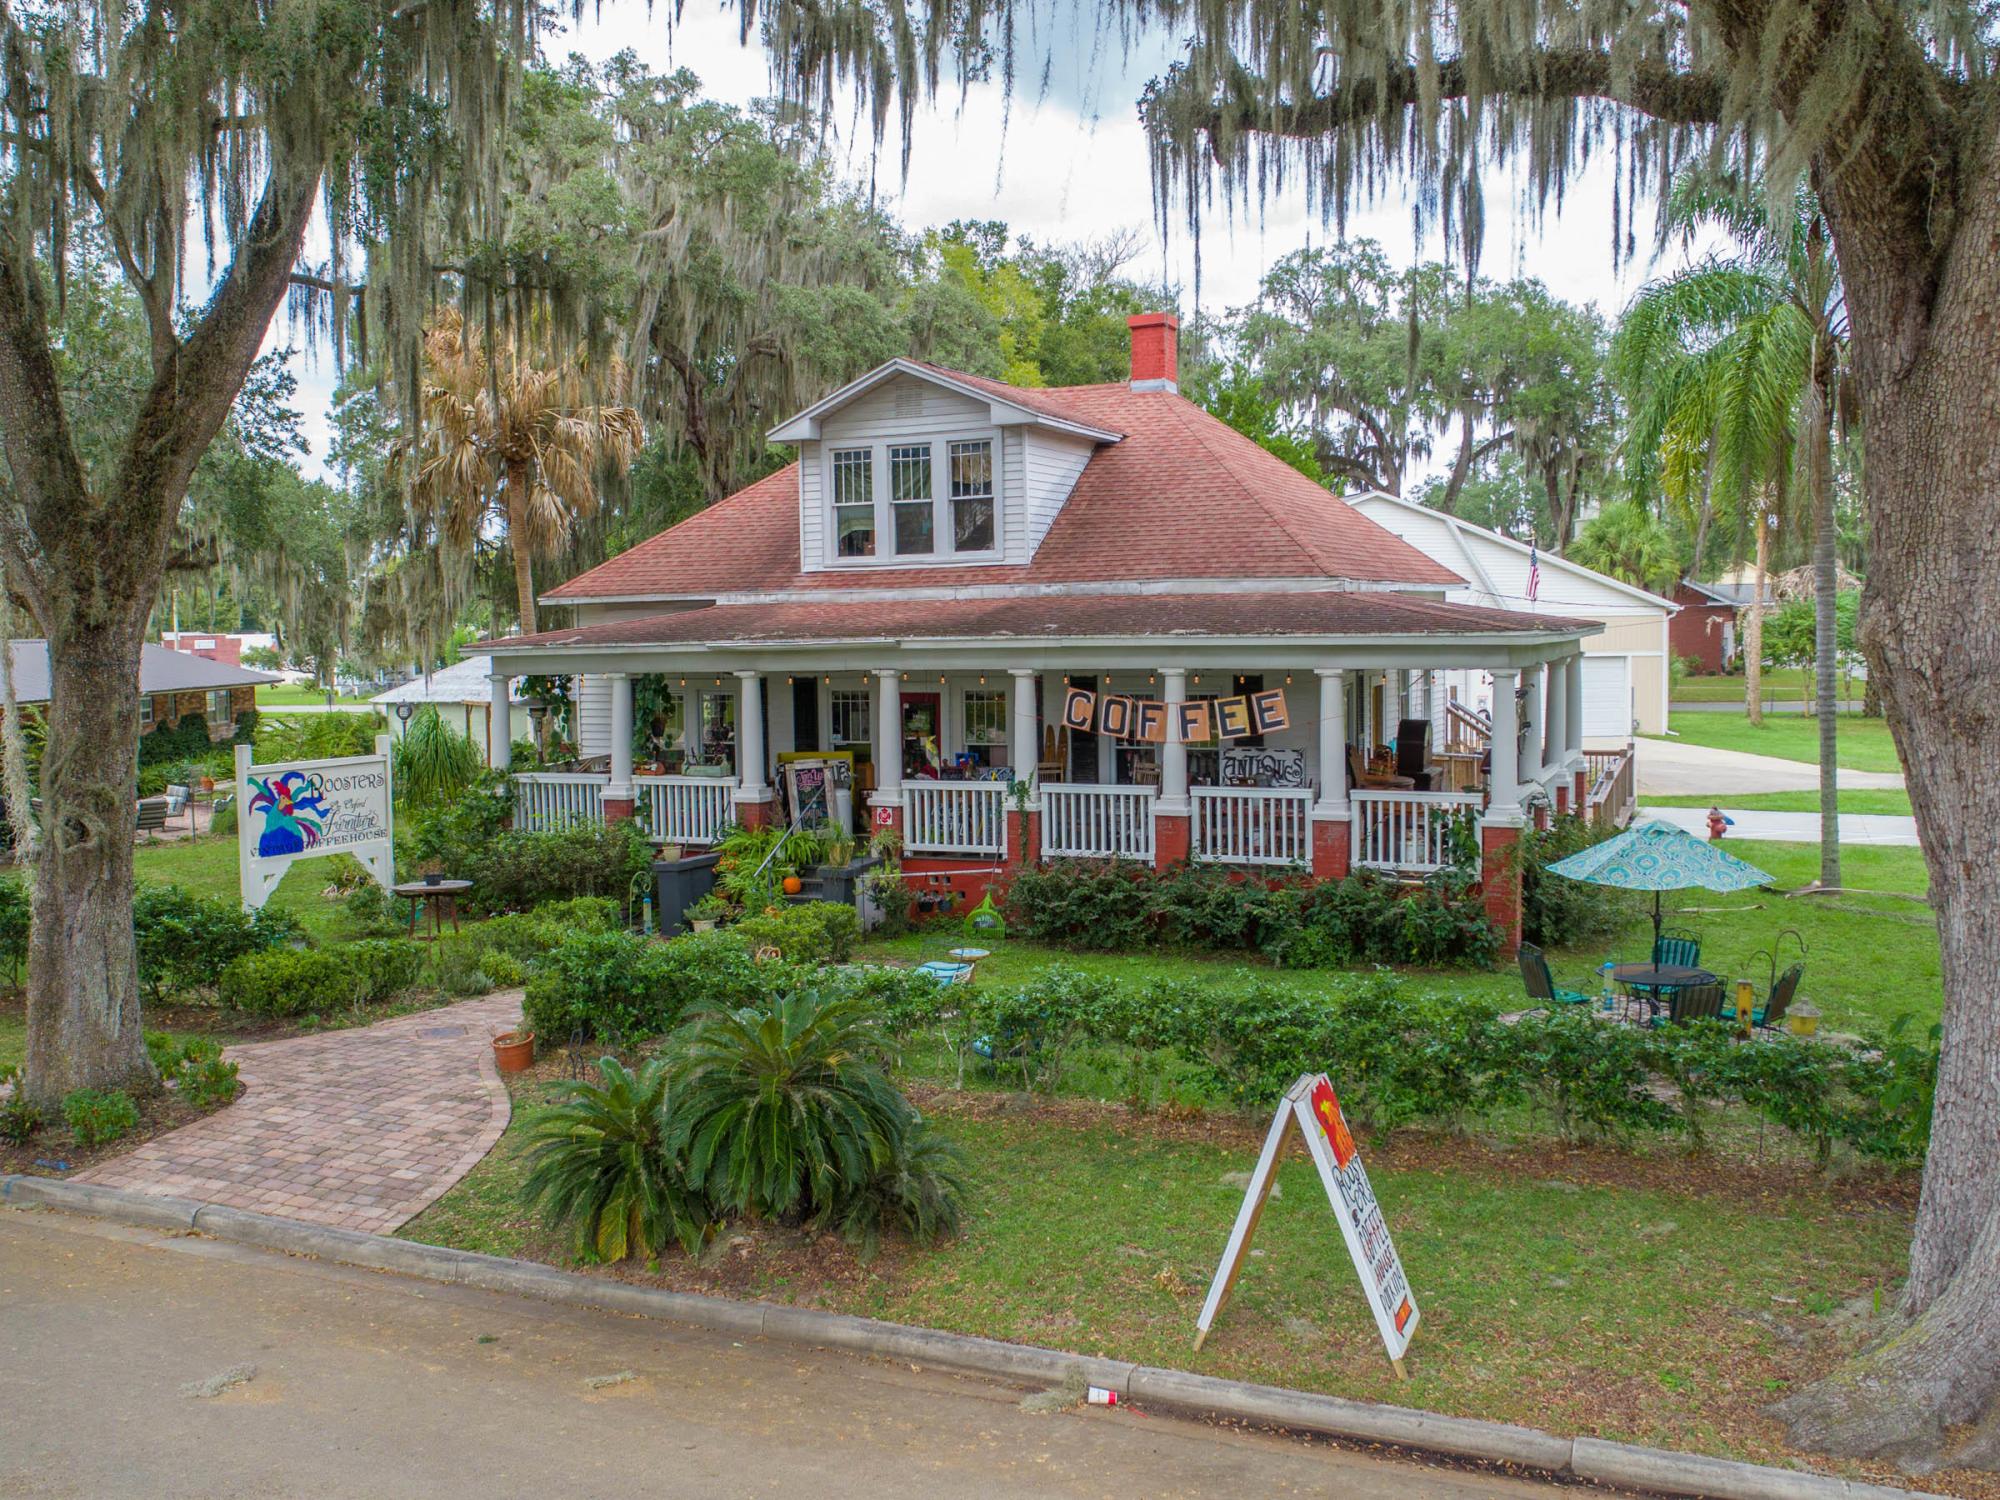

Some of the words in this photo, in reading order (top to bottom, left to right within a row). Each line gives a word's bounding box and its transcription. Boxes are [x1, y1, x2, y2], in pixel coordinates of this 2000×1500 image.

[1065, 690, 1286, 741] COFFEE
[307, 773, 385, 800] ROOSTERS
[1223, 755, 1303, 783] ANTIQUES
[1359, 1205, 1389, 1265] COFFEE
[1374, 1244, 1395, 1287] HOUSE
